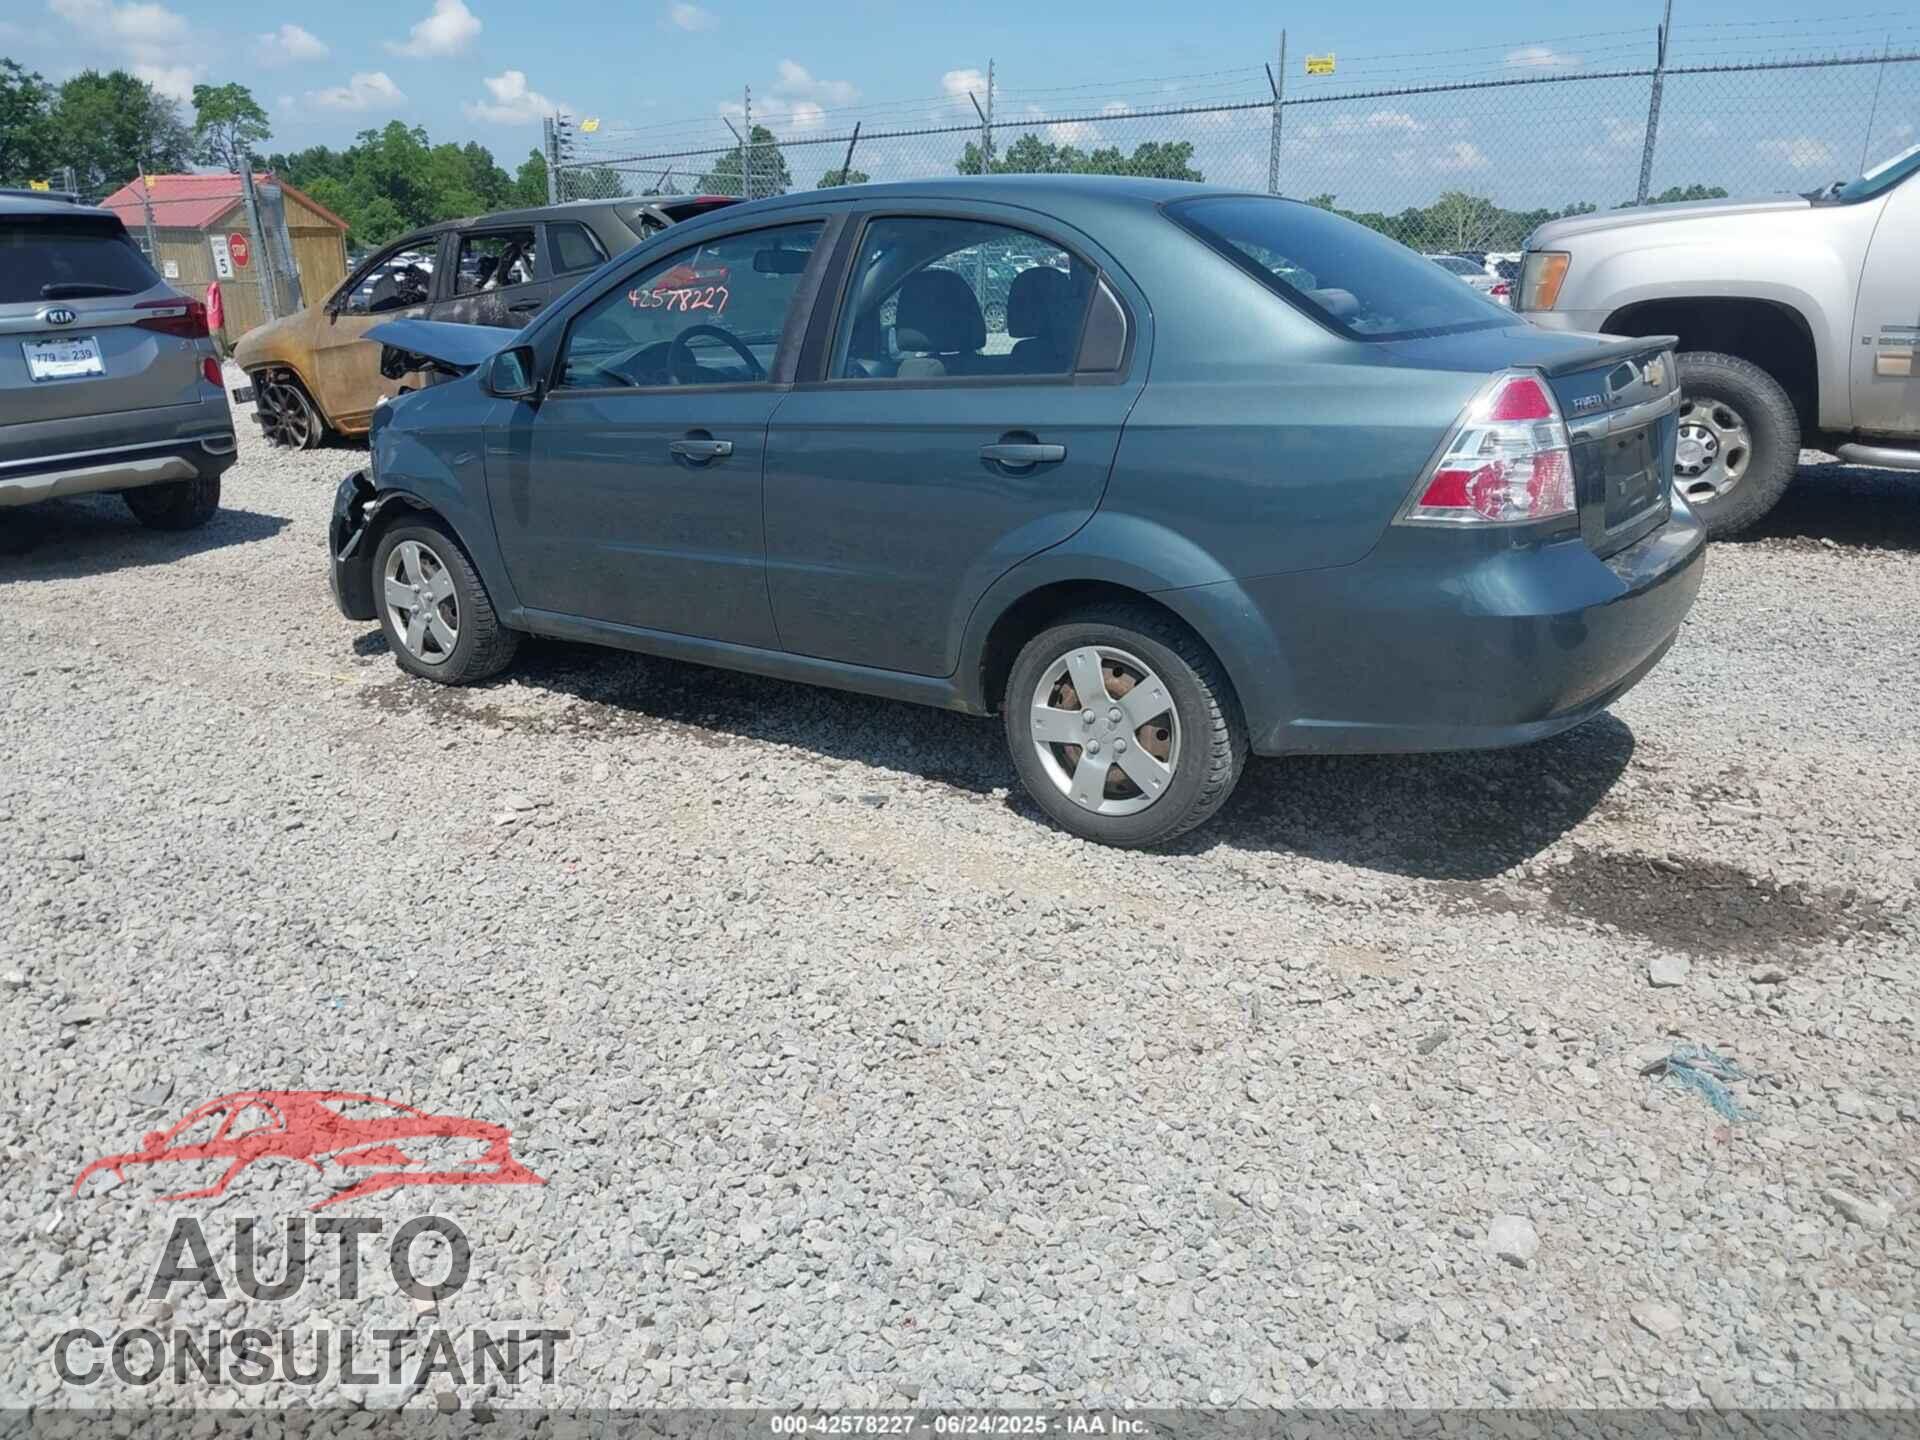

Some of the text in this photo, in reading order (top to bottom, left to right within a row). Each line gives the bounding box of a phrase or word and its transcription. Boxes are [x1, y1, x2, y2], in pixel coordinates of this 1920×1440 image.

[232, 244, 246, 257] STOP
[220, 258, 228, 274] 5
[628, 286, 729, 314] 42578227
[48, 311, 74, 323] KIA
